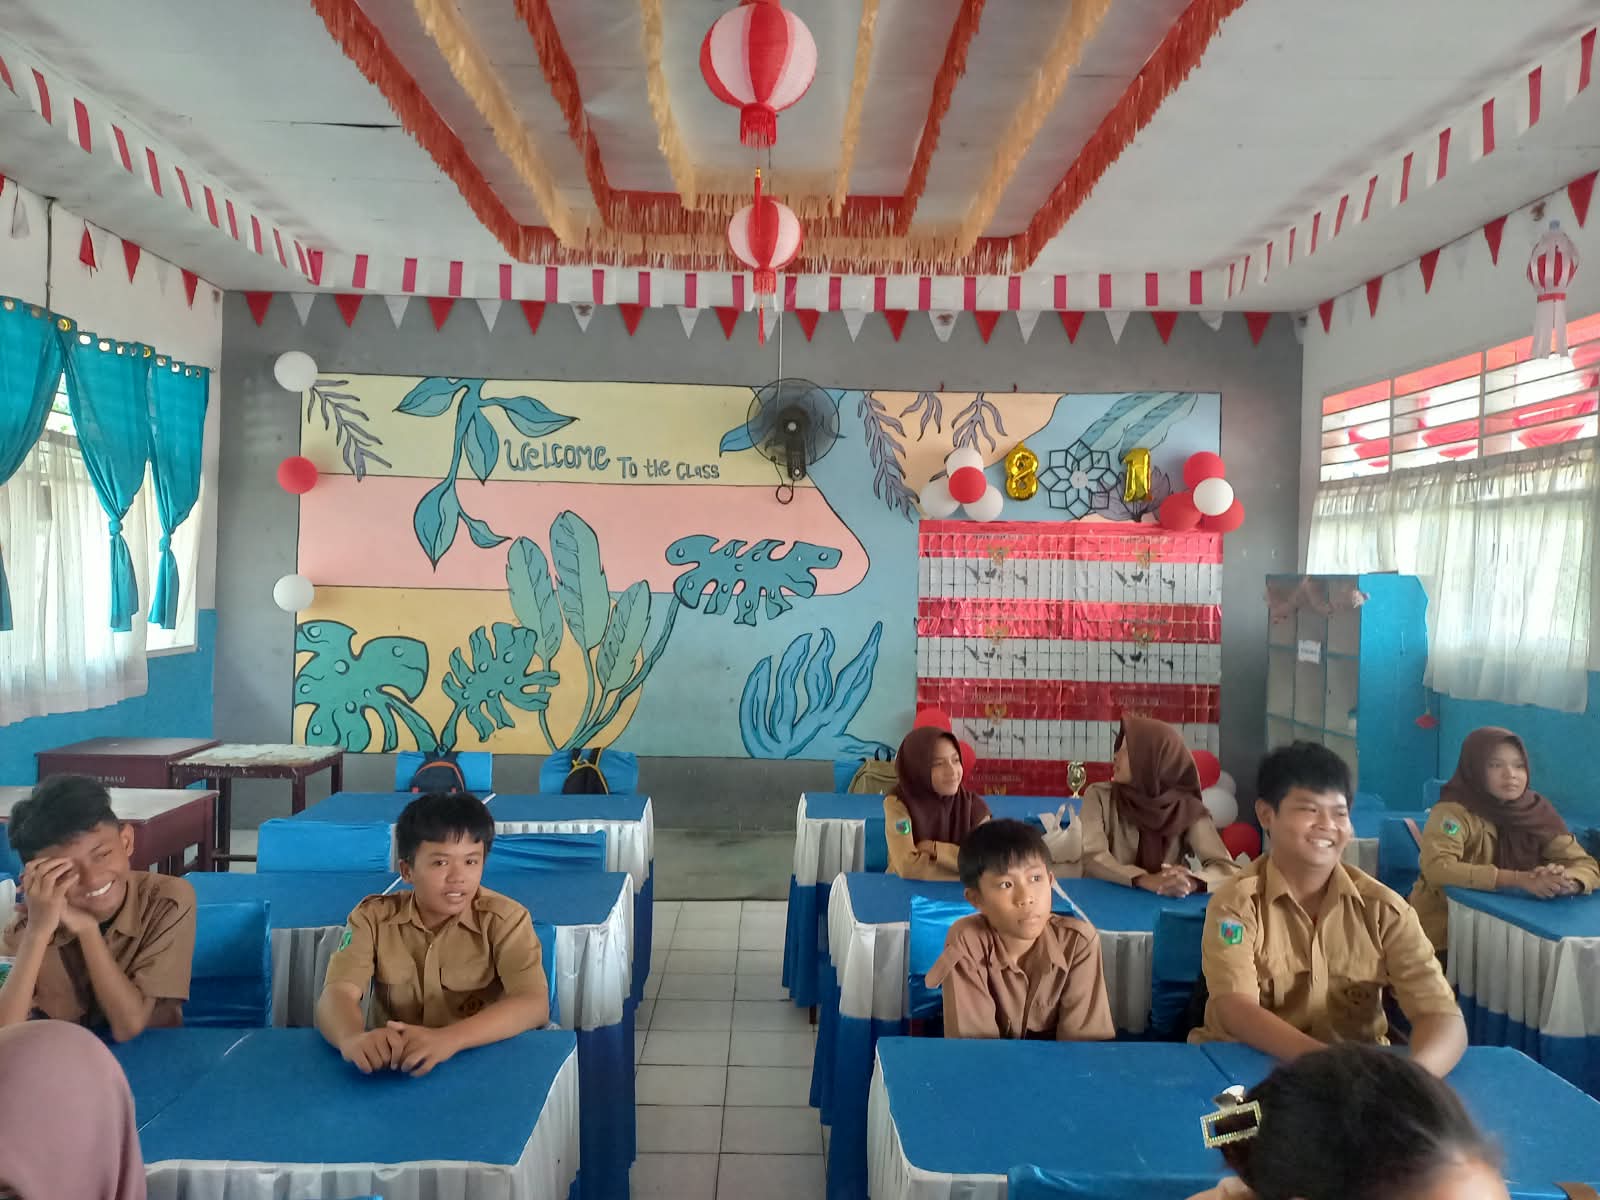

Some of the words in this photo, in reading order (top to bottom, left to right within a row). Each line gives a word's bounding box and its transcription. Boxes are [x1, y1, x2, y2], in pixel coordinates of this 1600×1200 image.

[617, 456, 638, 479] To
[643, 459, 671, 477] the
[1005, 444, 1039, 501] 8
[1123, 447, 1151, 503] 1
